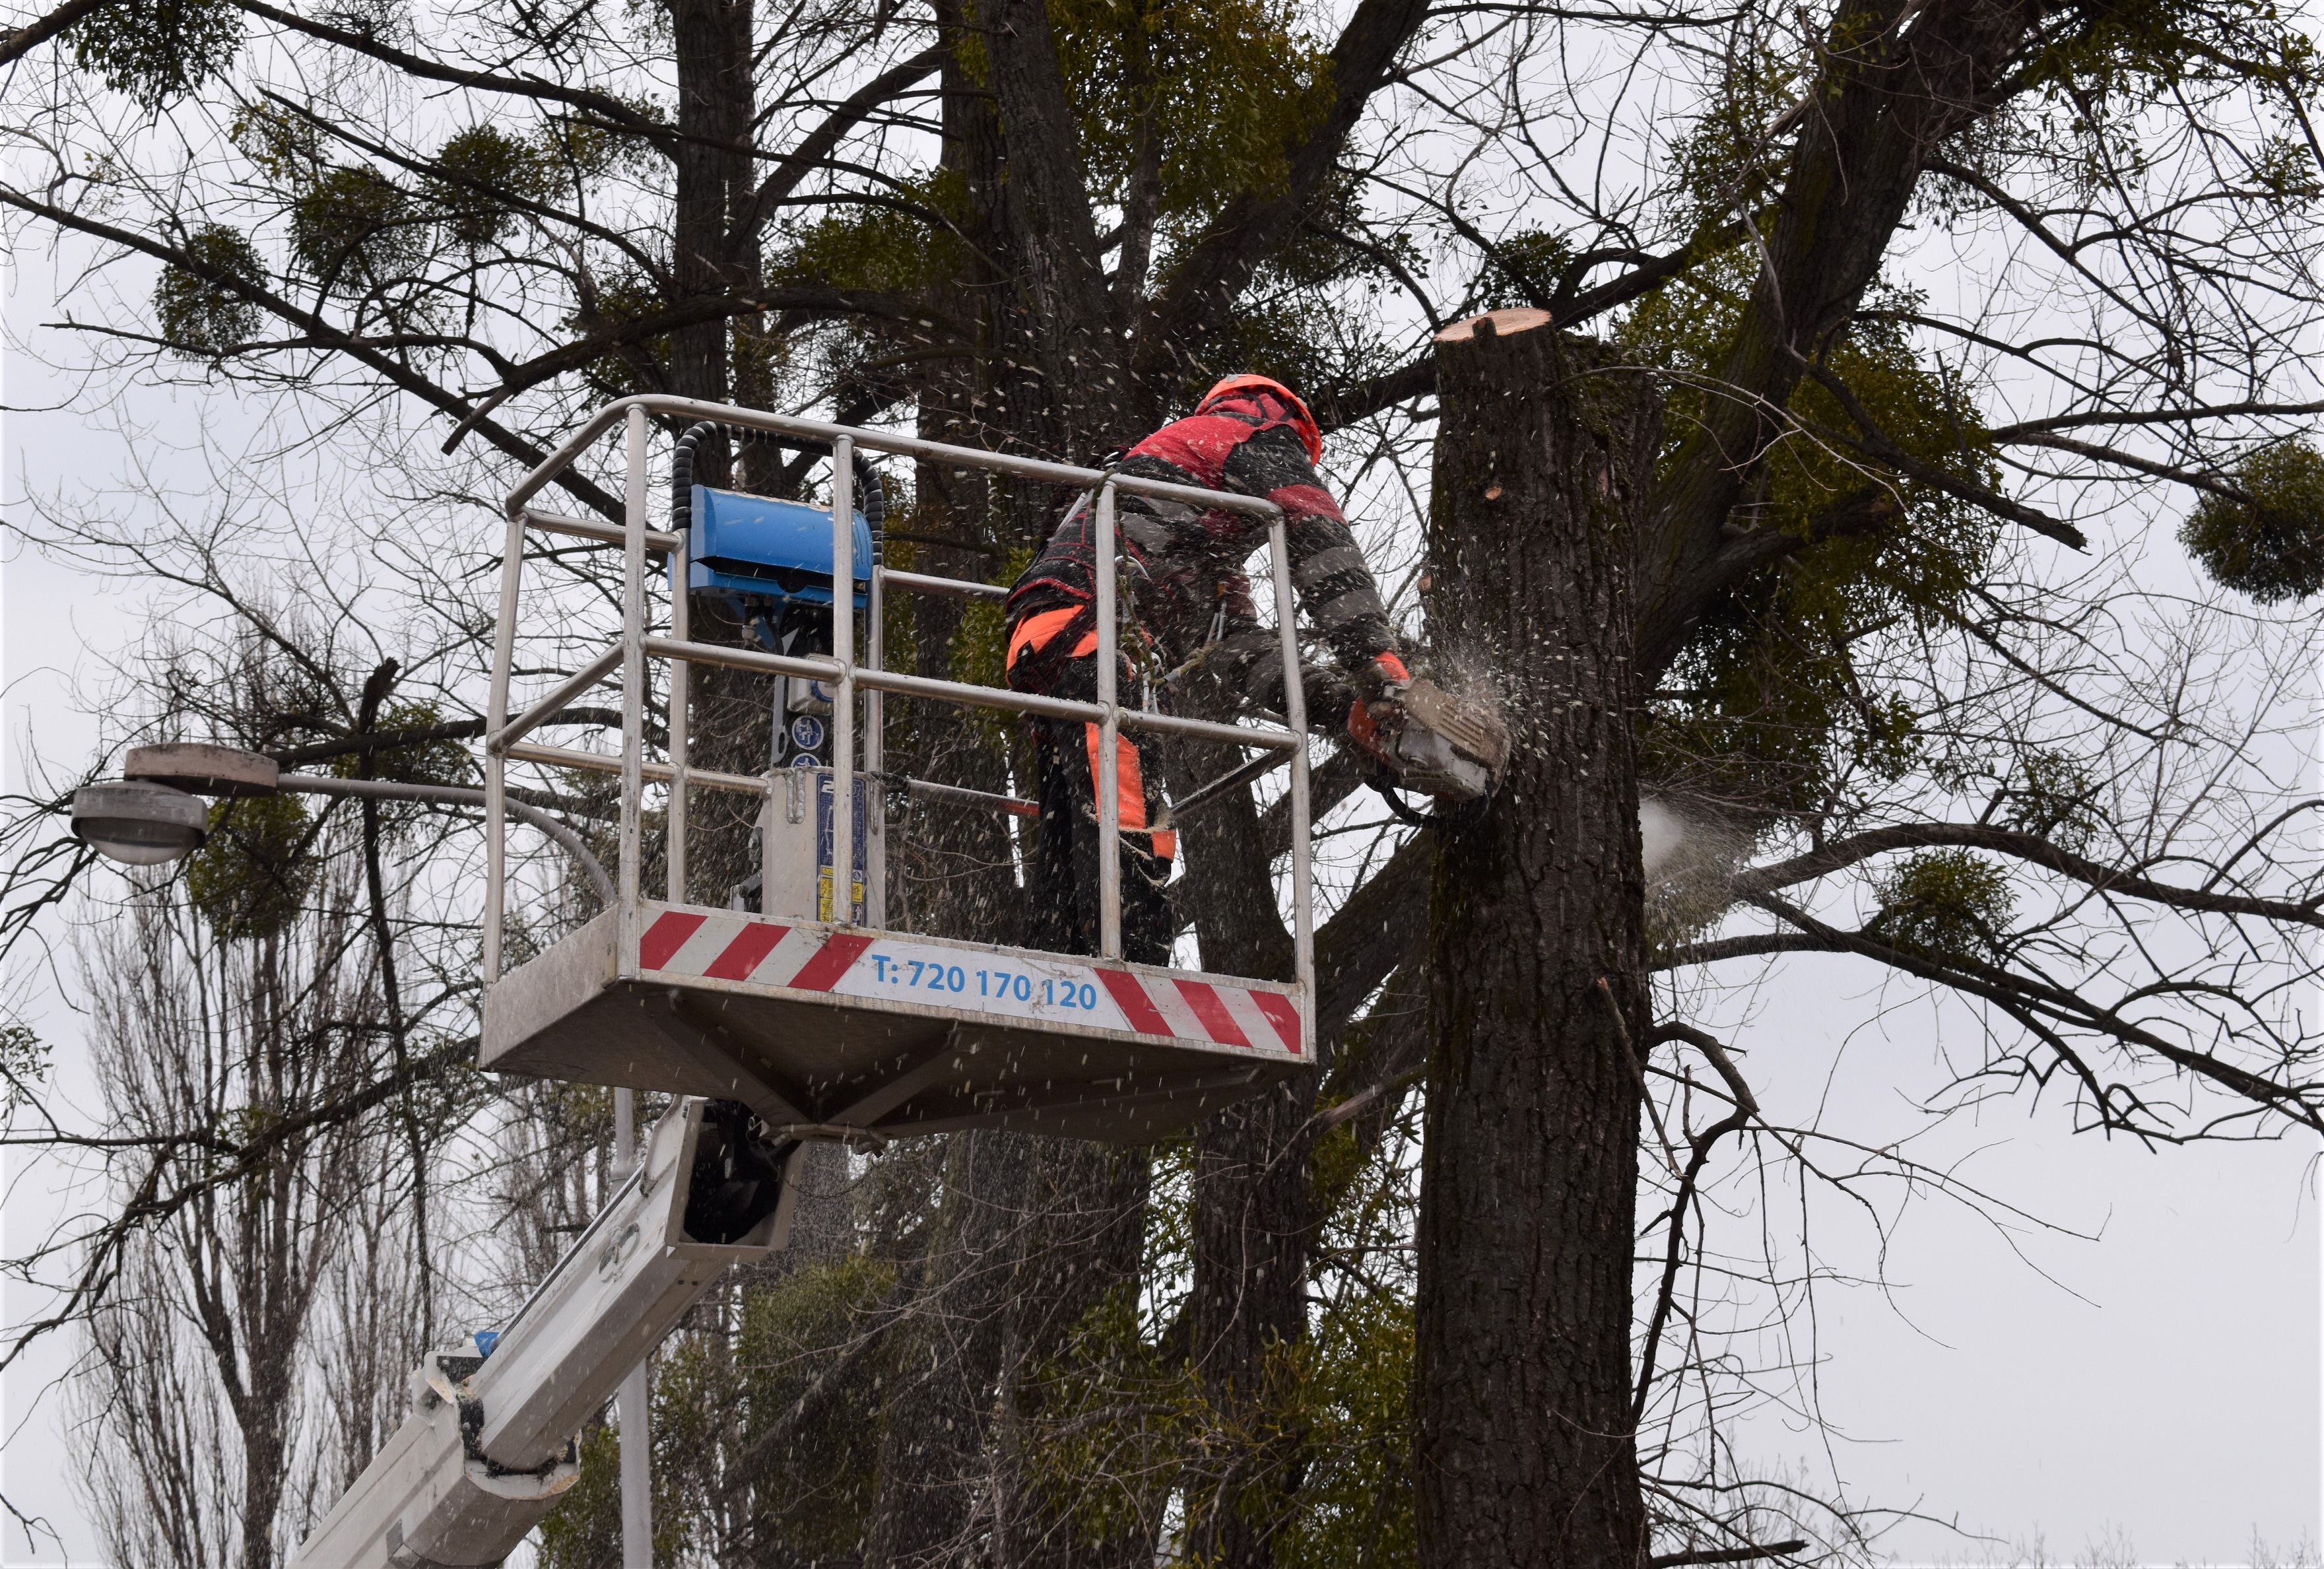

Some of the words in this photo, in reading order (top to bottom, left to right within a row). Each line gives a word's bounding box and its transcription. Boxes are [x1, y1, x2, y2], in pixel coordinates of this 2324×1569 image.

[871, 954, 898, 984] T:
[908, 960, 965, 993] 720
[976, 970, 1031, 1001] 170
[1041, 979, 1097, 1010] 120
